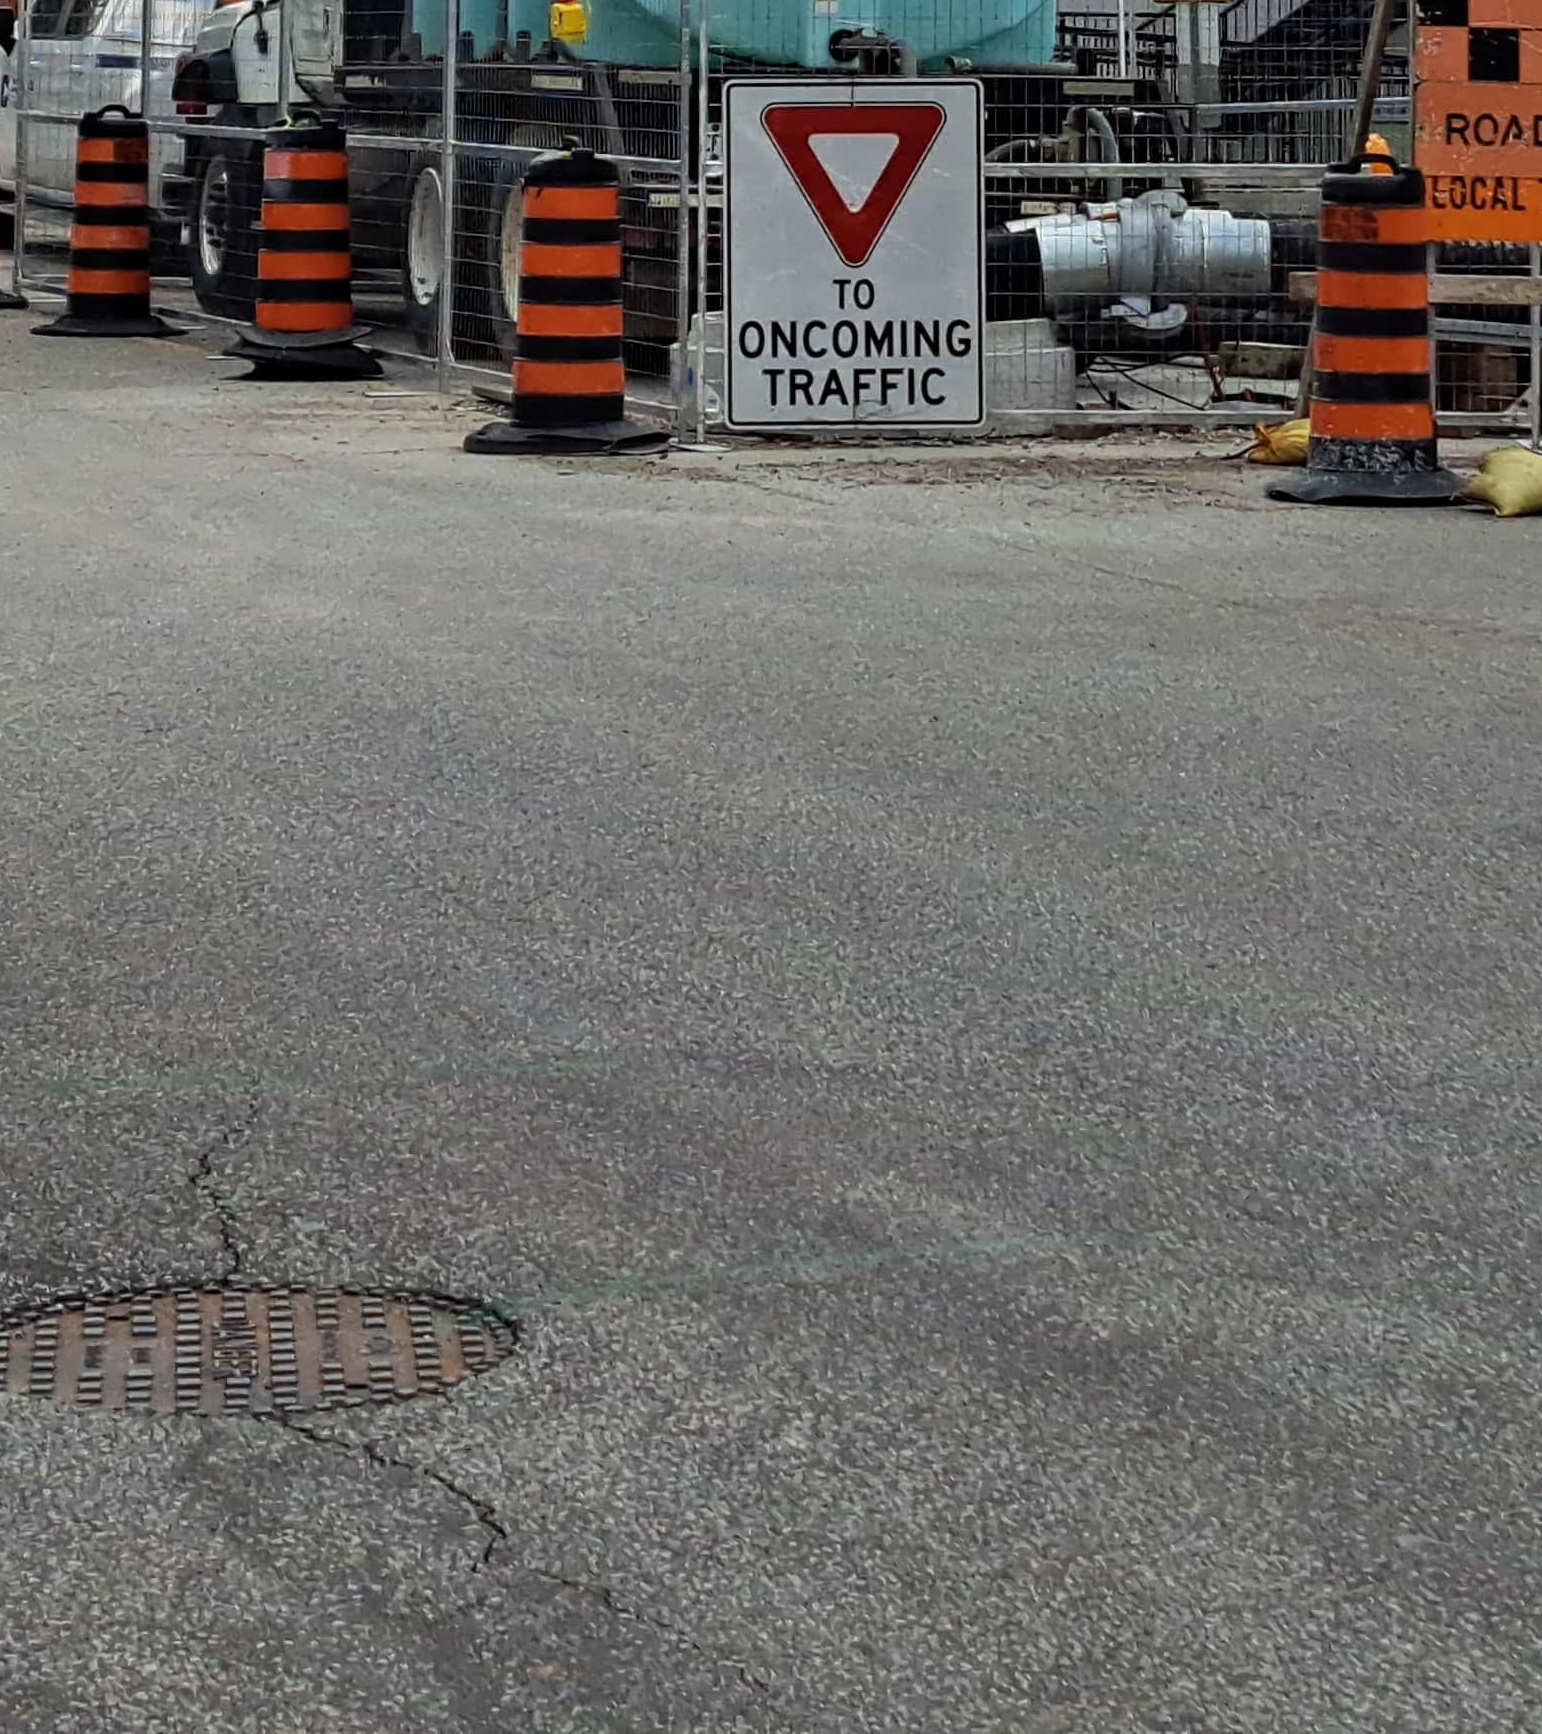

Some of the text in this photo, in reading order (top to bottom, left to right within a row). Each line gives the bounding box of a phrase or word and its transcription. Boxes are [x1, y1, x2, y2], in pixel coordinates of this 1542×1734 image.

[1432, 176, 1526, 211] LOCAL
[832, 279, 875, 310] TO
[738, 319, 972, 358] ONCOMING
[762, 368, 946, 407] TRAFFIC
